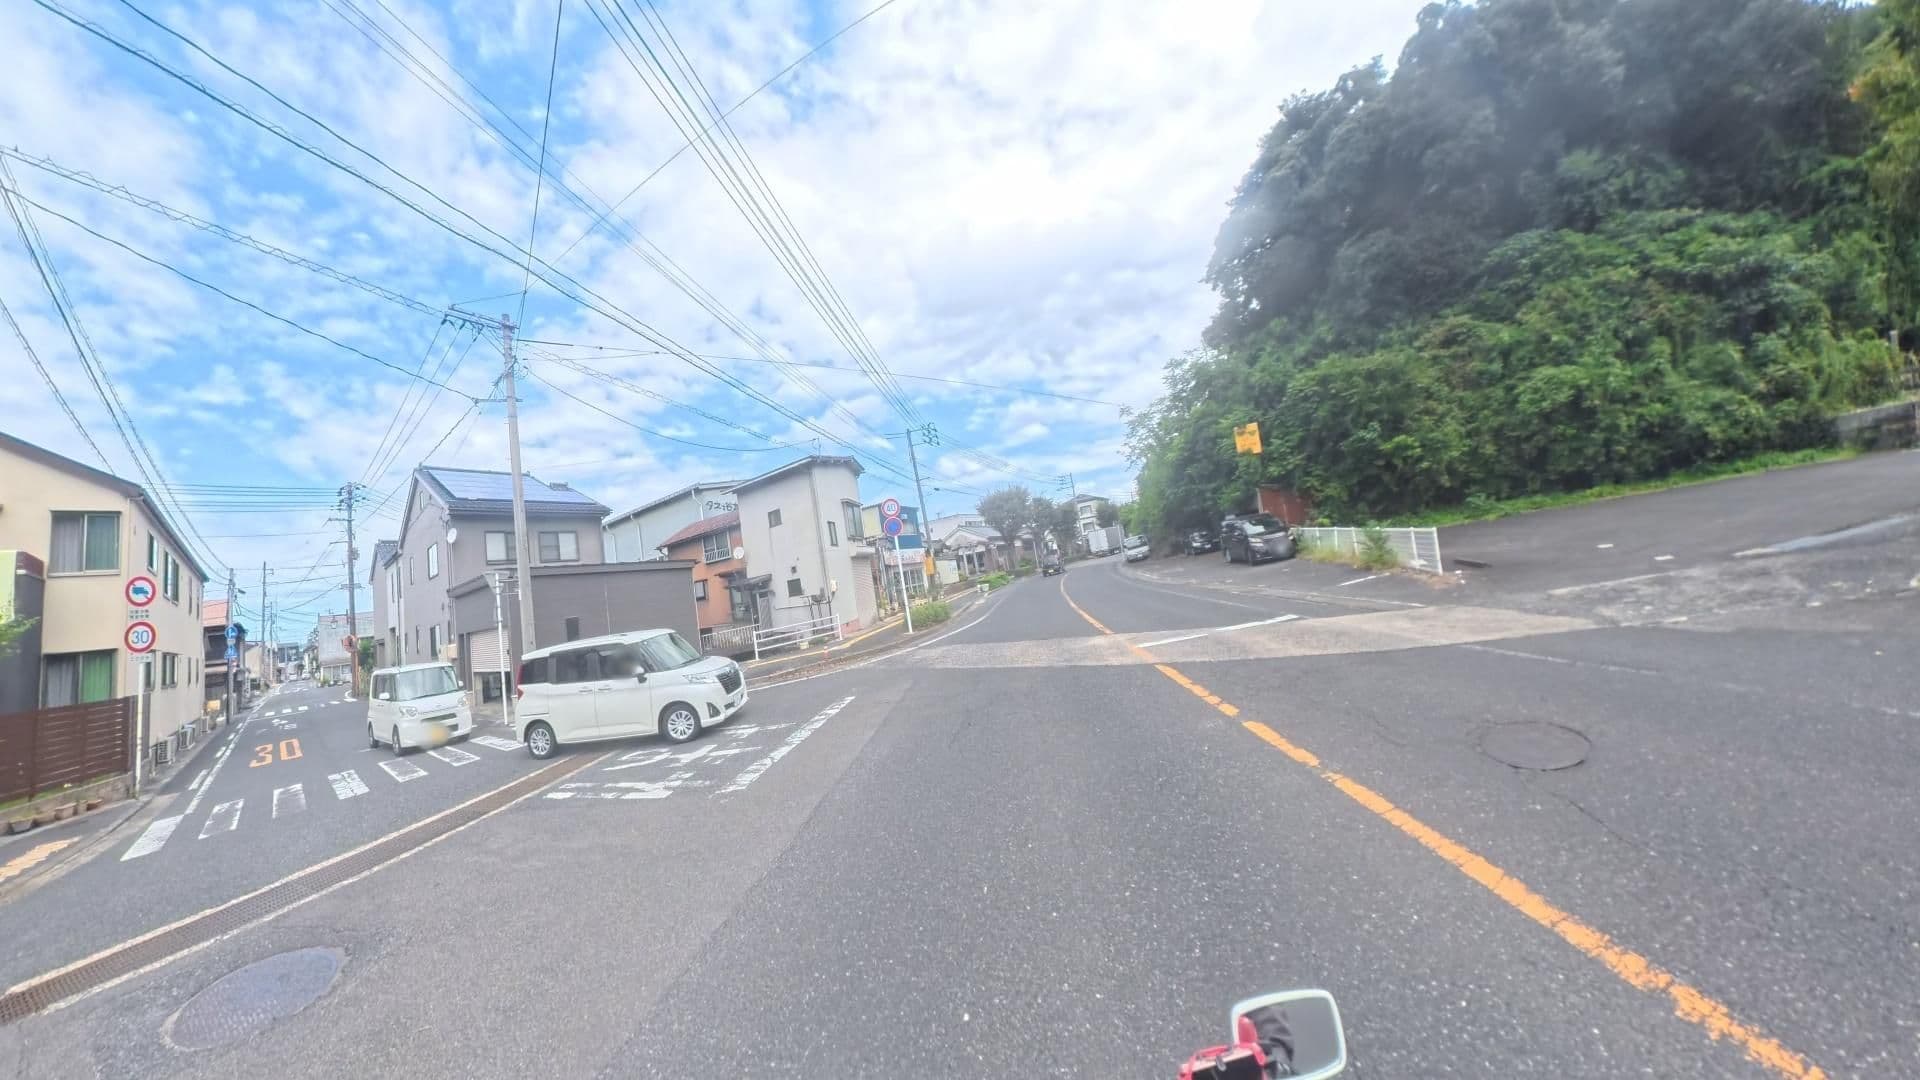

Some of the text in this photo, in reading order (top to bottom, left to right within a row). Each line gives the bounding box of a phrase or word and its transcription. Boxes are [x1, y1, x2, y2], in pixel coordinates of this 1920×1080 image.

[886, 503, 896, 512] 40
[131, 630, 150, 644] 30
[249, 738, 303, 768] 30
